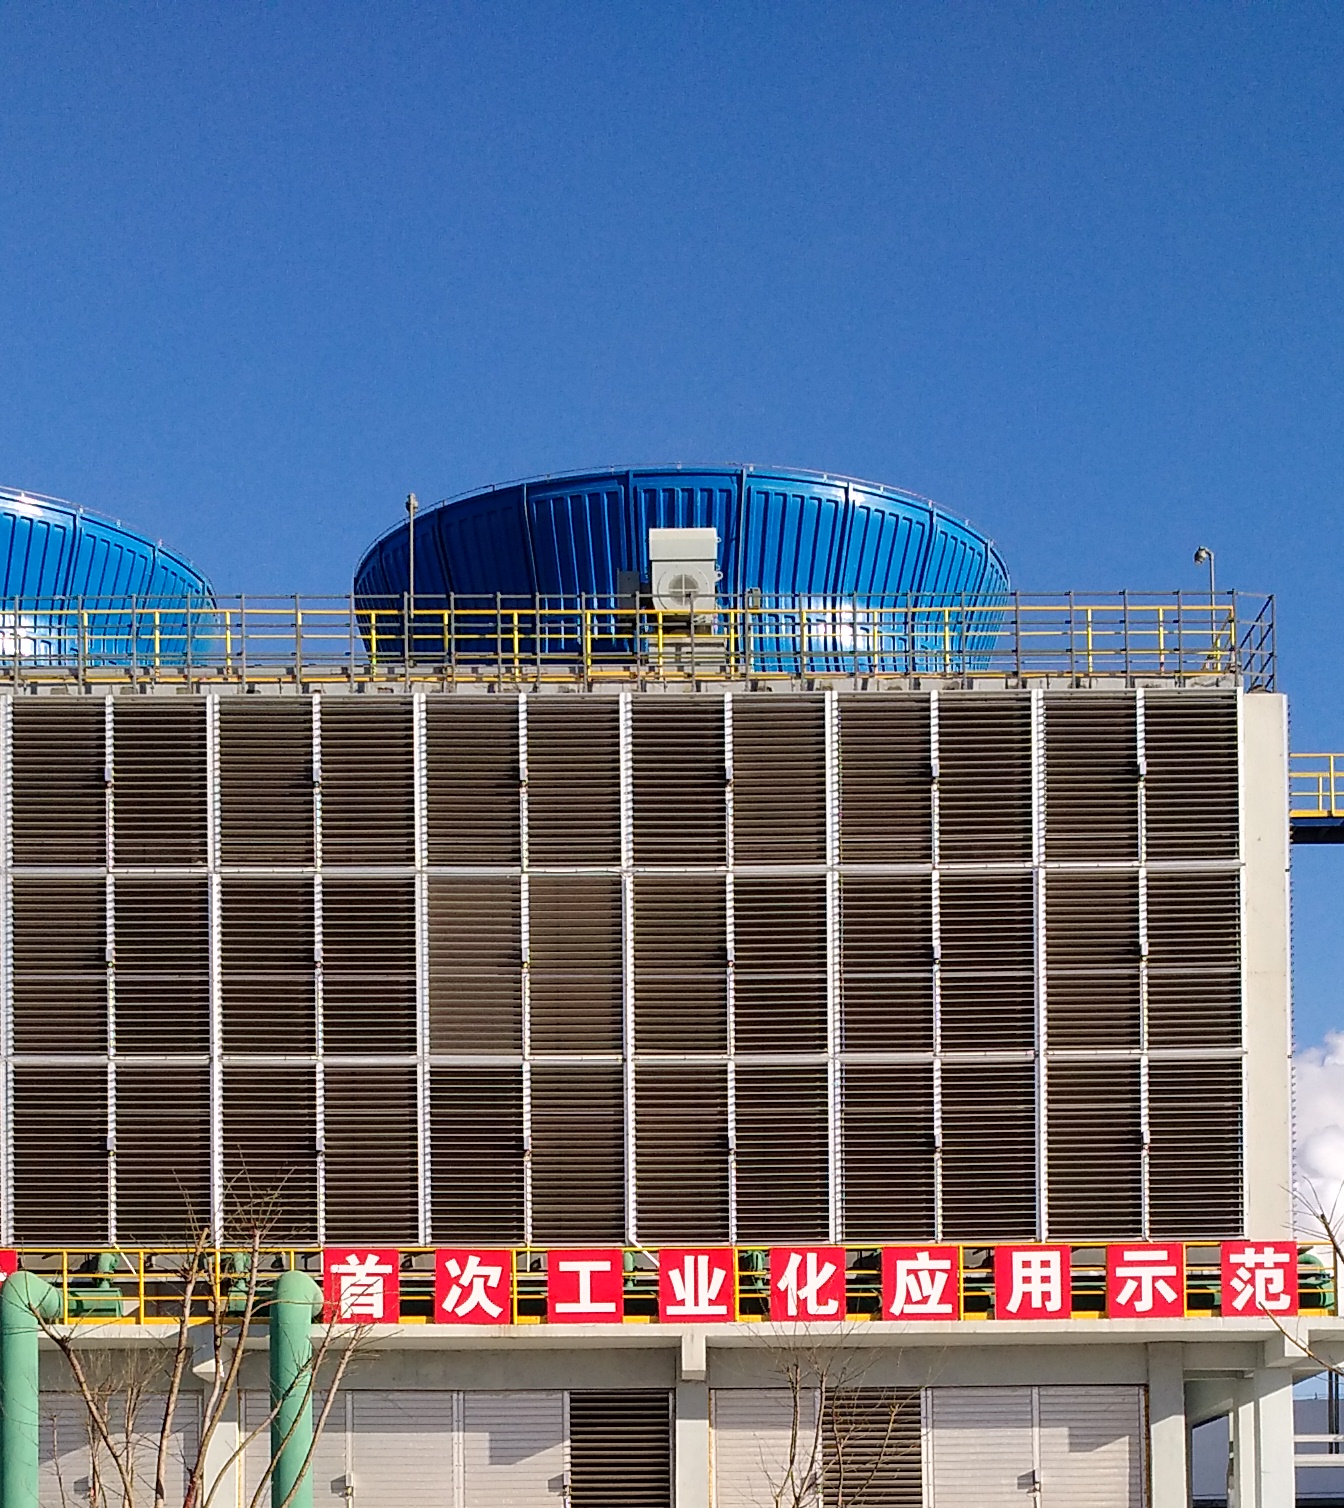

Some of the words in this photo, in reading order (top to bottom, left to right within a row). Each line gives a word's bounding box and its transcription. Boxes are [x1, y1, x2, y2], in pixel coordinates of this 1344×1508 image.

[330, 1248, 1292, 1318] 首次工业化应用示范
